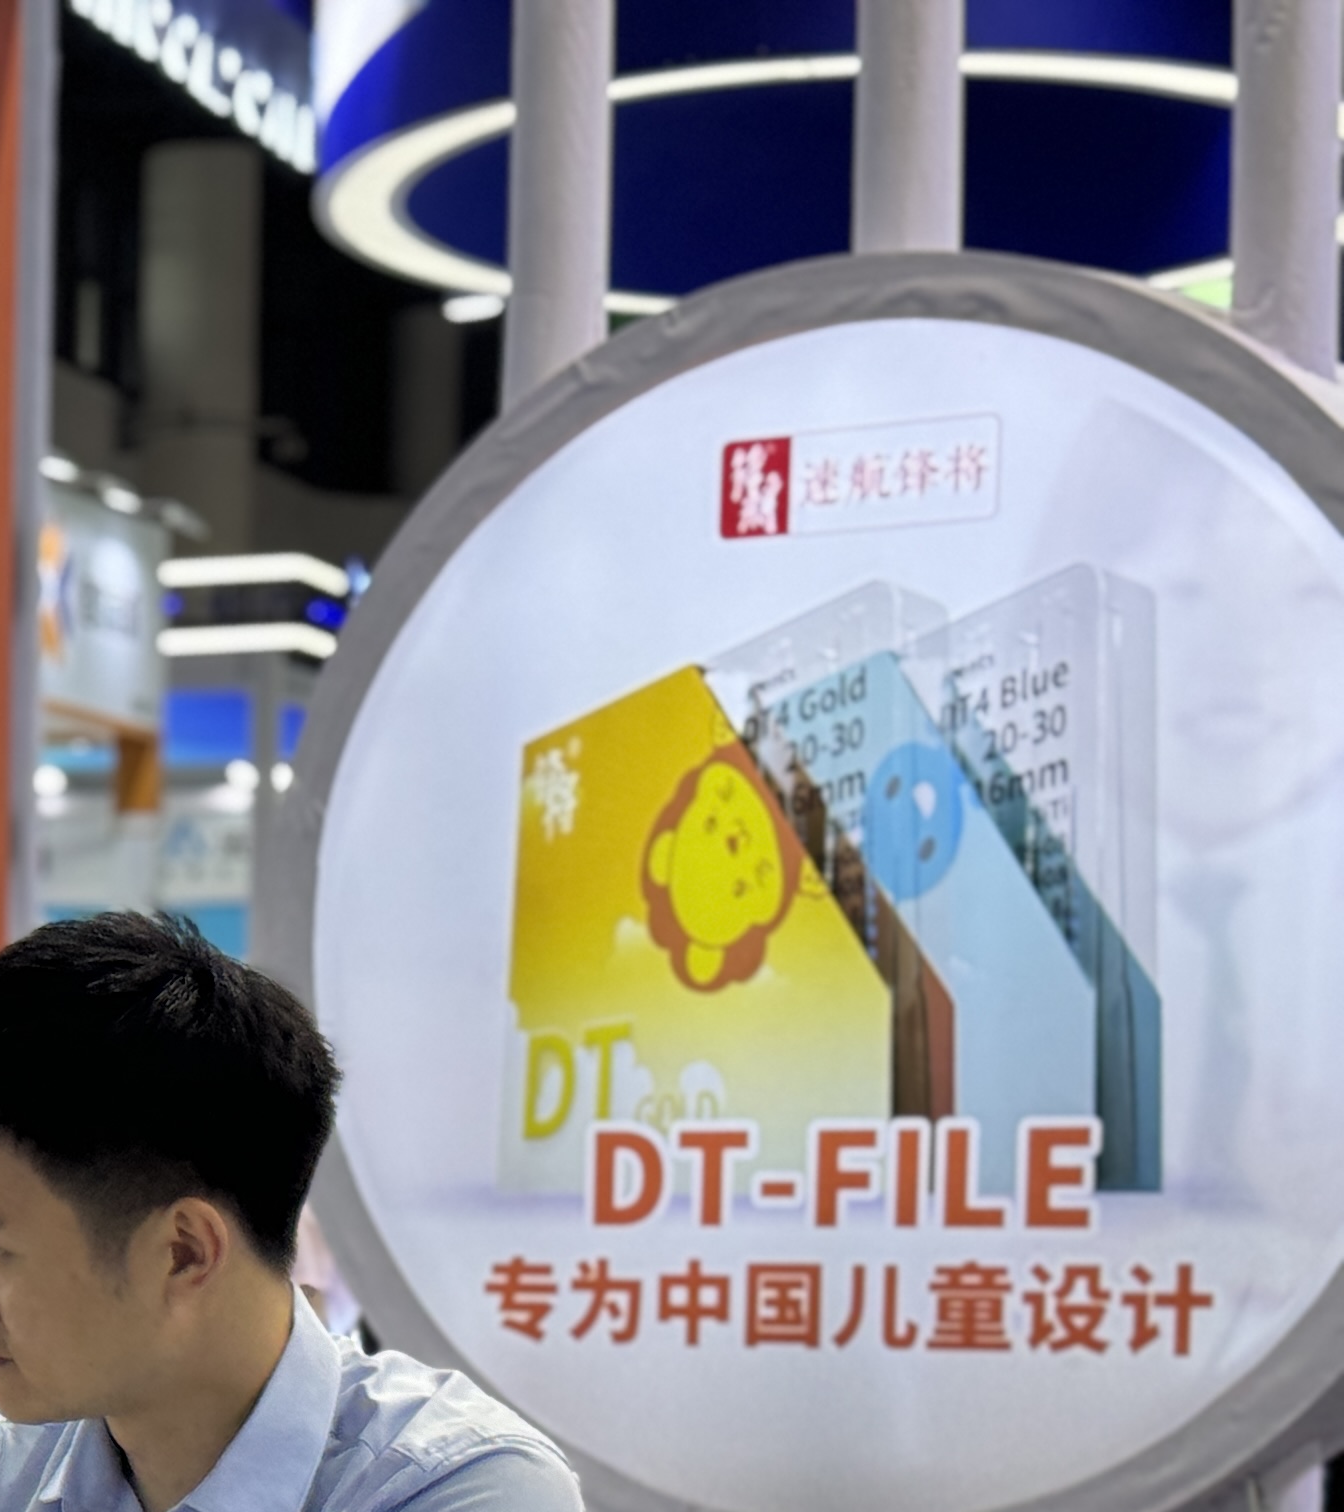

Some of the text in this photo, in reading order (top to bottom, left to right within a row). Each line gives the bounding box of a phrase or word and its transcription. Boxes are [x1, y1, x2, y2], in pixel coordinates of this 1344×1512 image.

[798, 666, 868, 722] Gold
[999, 660, 1070, 711] Blue
[982, 705, 1068, 763] 20-30
[523, 1022, 632, 1140] DT
[591, 1127, 1094, 1228] DT-FILE
[484, 1259, 1215, 1357] 专为中国儿童设计
